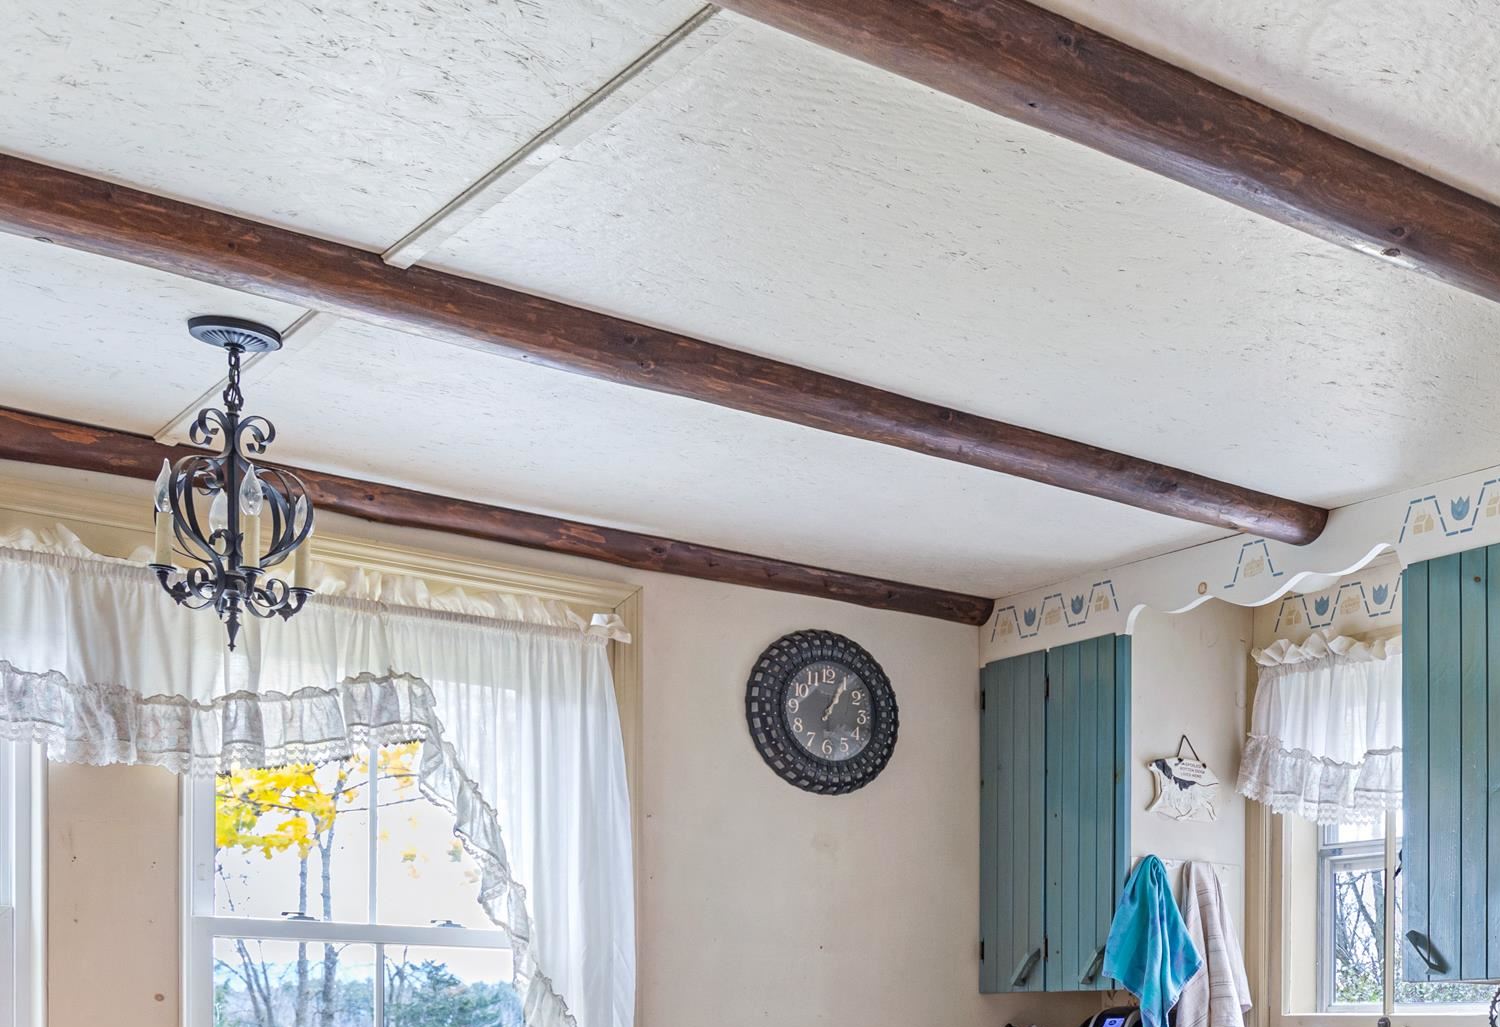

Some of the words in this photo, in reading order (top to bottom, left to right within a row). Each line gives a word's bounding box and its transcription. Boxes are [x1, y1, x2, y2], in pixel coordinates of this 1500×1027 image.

[808, 671, 818, 686] 11
[822, 669, 836, 684] 12
[795, 682, 809, 698] 10
[851, 690, 861, 706] 2
[788, 698, 799, 714] 9
[792, 717, 803, 733] 8
[856, 710, 867, 725] 3
[806, 731, 816, 747] 7
[850, 726, 861, 741] 4
[821, 739, 833, 755] 6
[840, 737, 849, 753] 5
